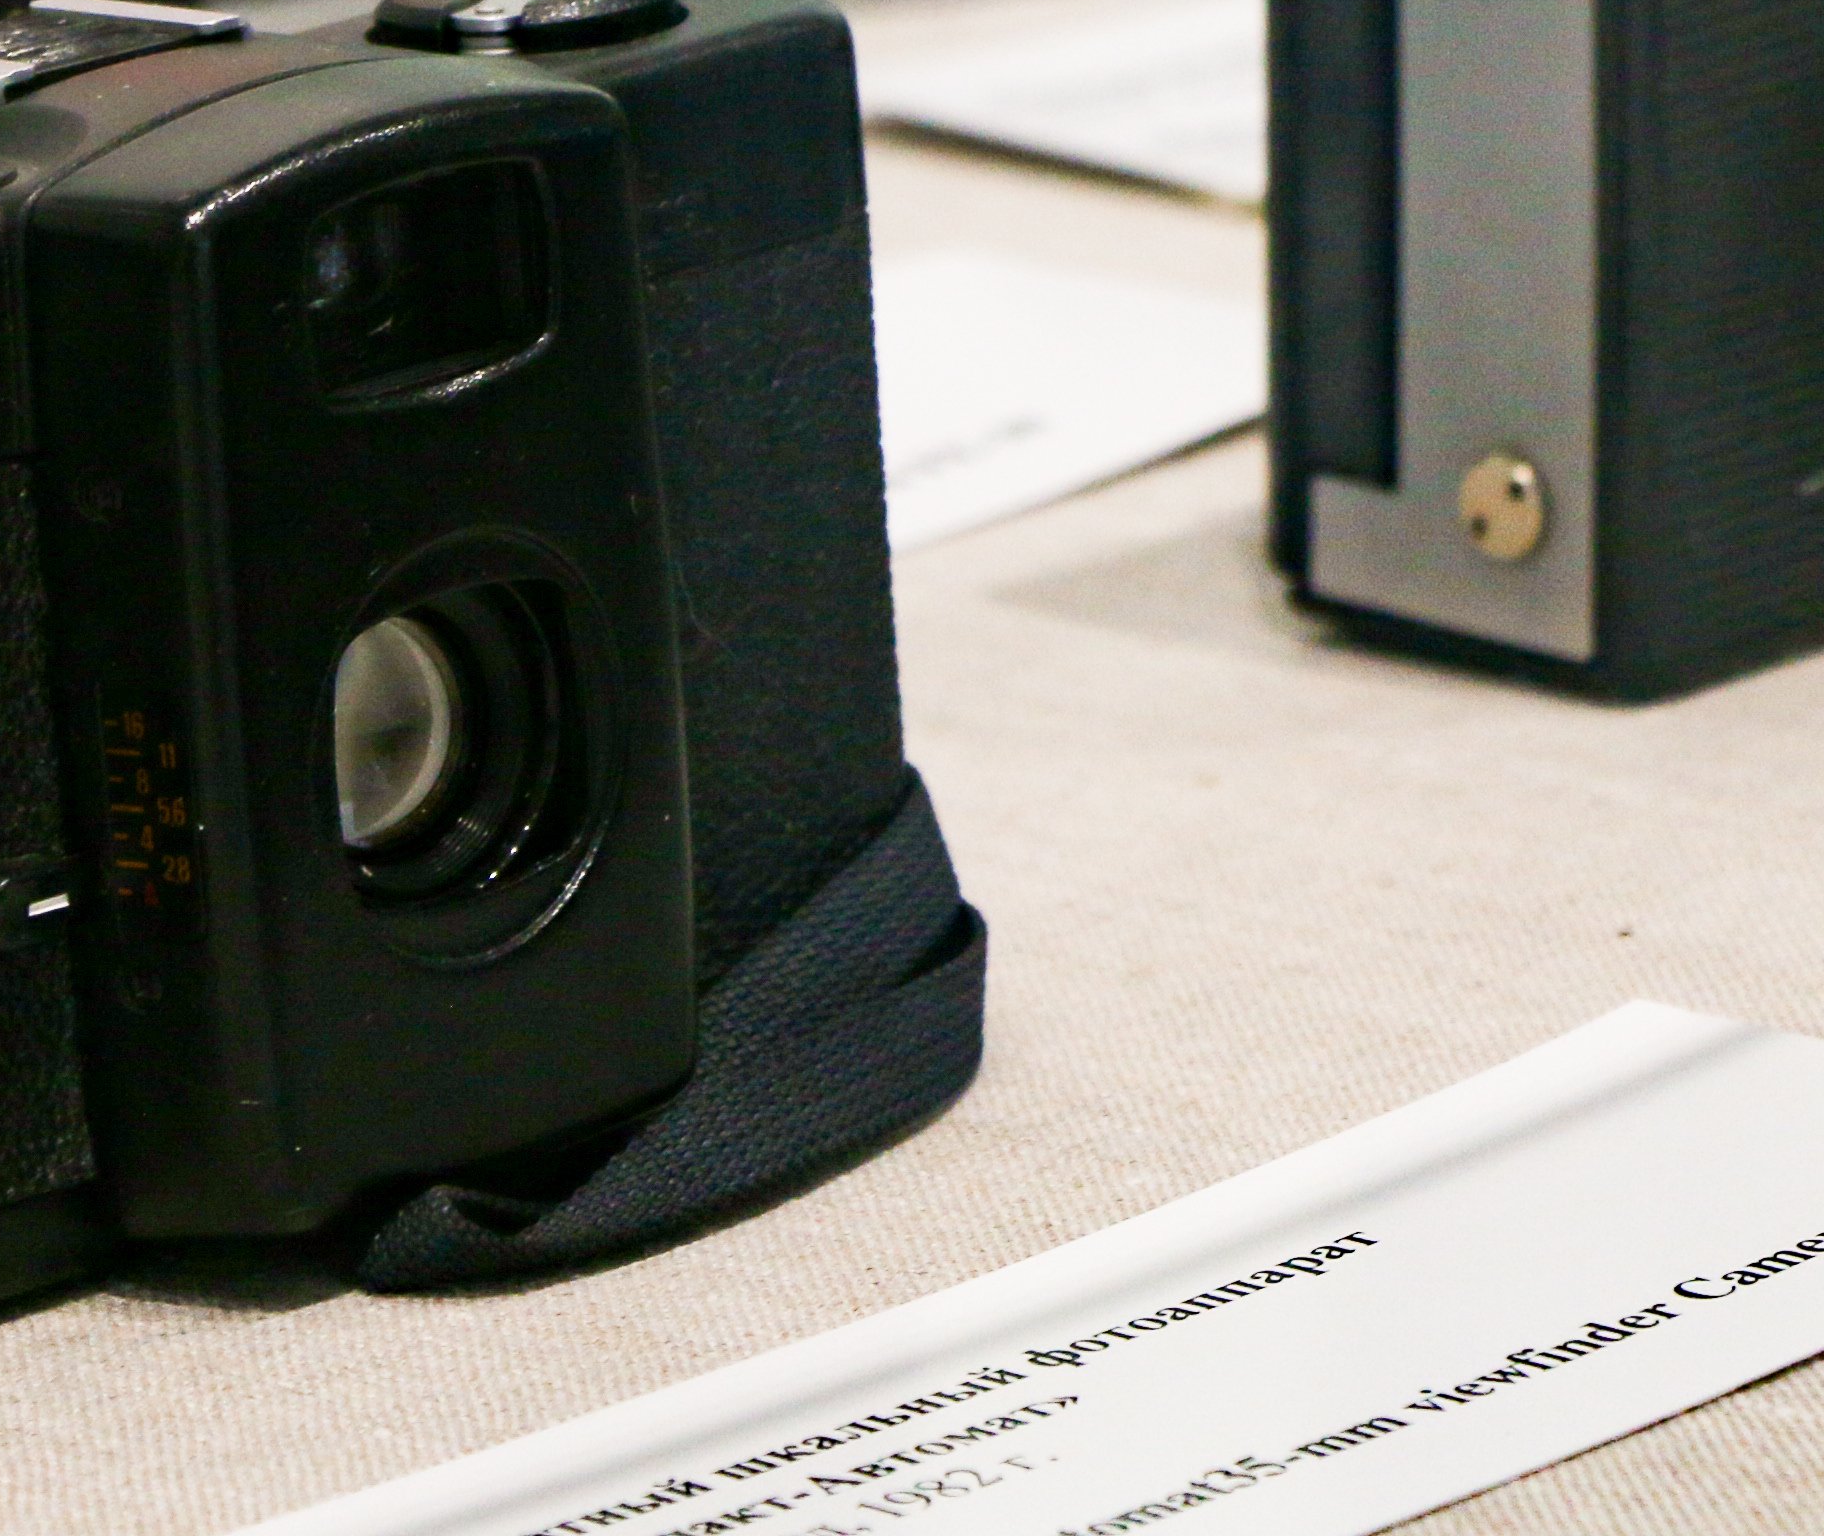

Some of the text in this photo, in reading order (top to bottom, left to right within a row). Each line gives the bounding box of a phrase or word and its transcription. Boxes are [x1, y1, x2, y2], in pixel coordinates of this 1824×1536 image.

[521, 1228, 1378, 1536] тный шкальный фотоаппарат
[1402, 1298, 1682, 1415] viewfinder
[661, 1394, 1079, 1536] акт-Автомат»
[856, 1467, 1004, 1517] 1982
